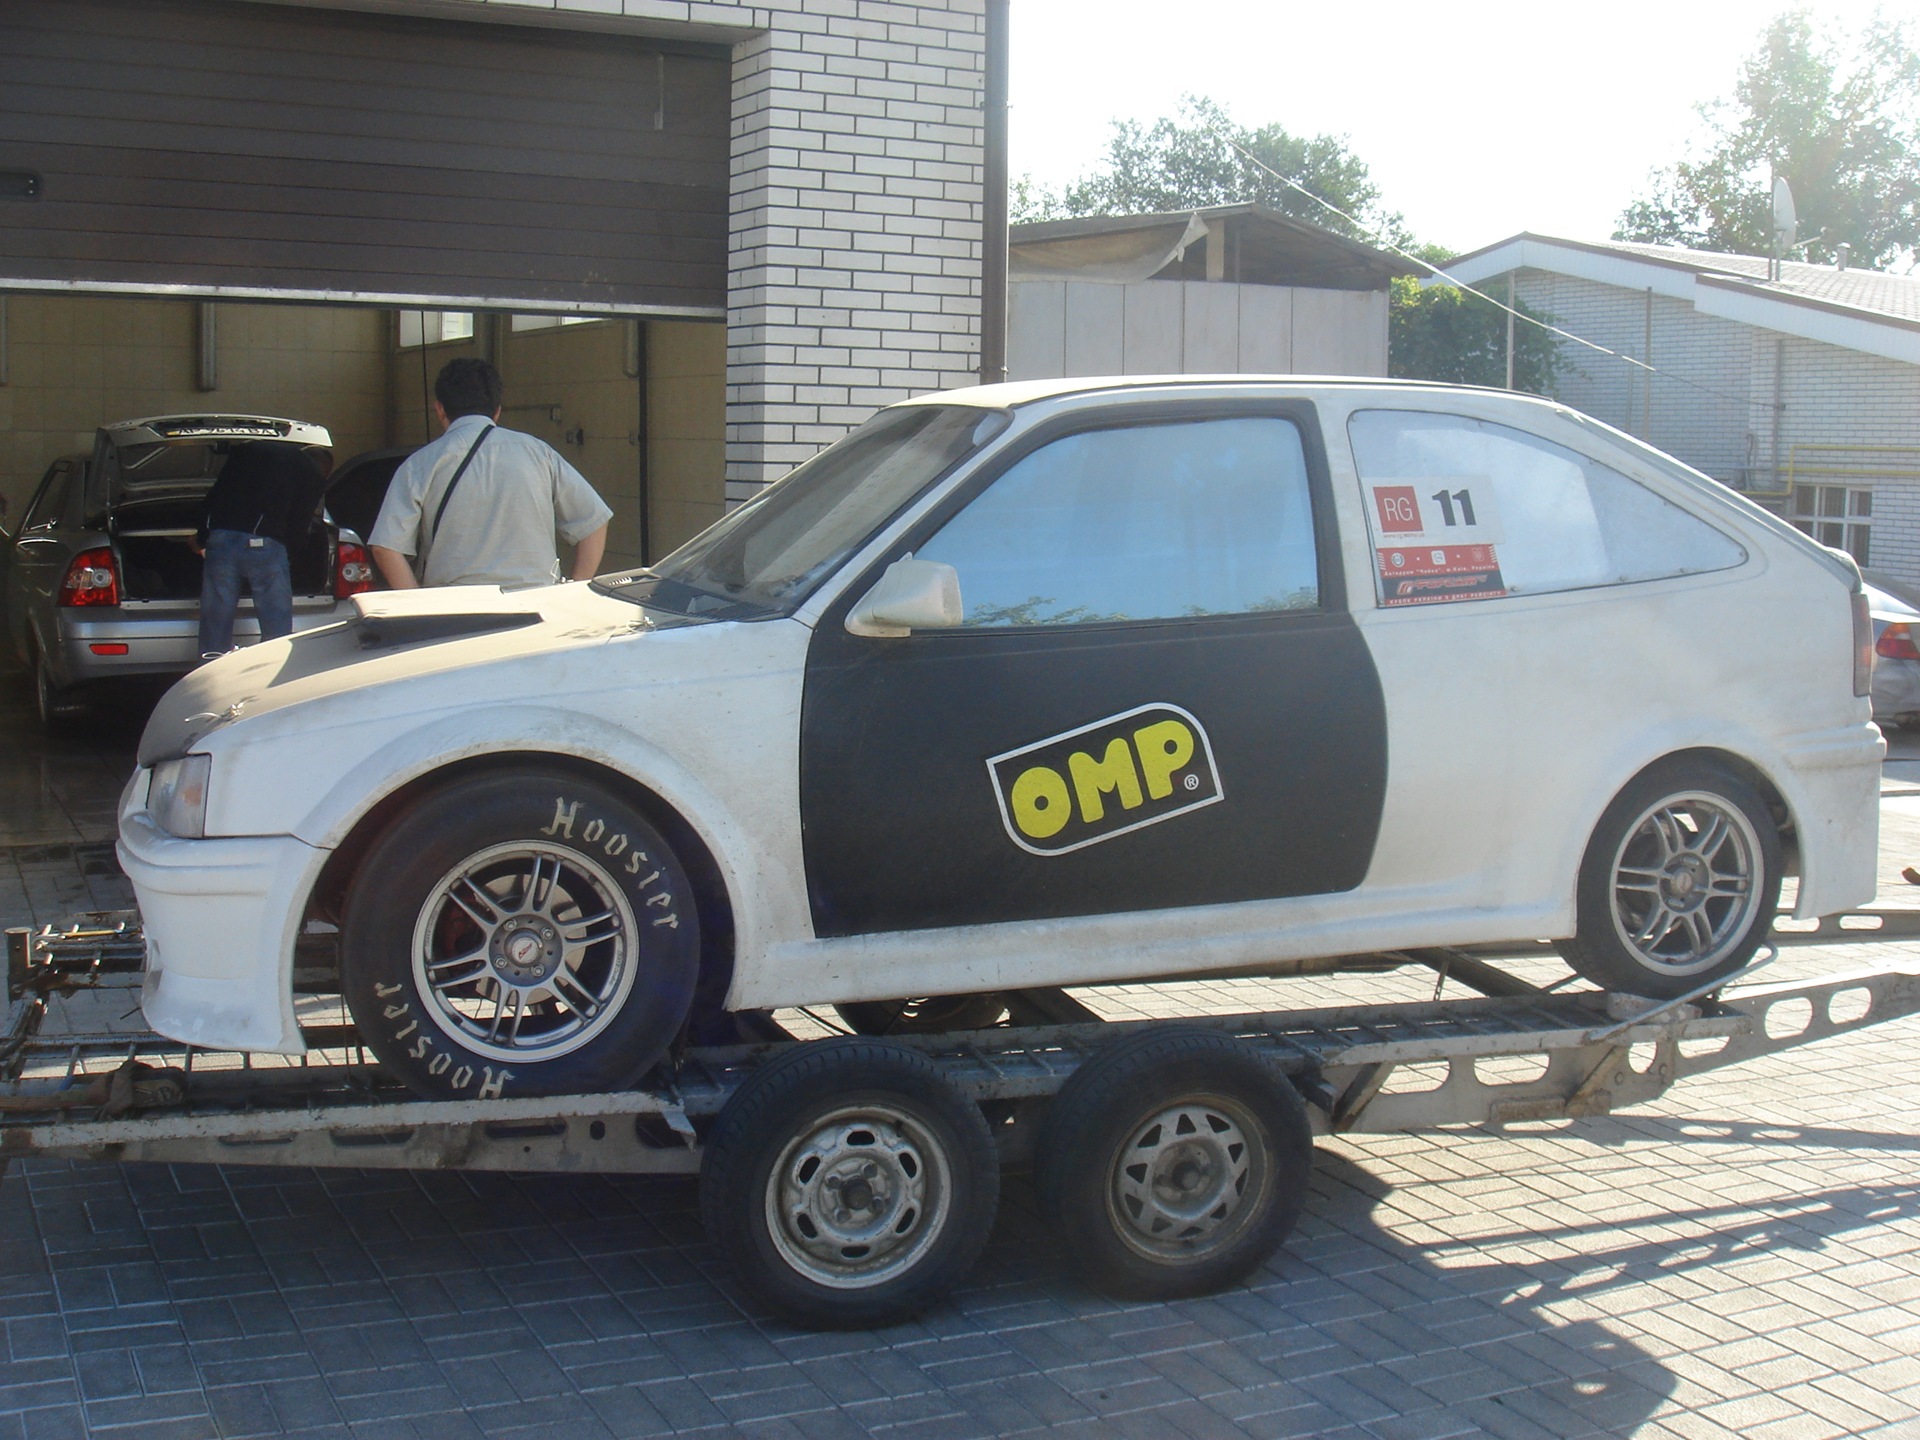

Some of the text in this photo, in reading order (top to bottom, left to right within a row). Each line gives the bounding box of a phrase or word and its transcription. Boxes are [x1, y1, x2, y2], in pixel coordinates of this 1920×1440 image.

[1383, 497, 1414, 521] RG
[1431, 489, 1477, 526] 11
[1011, 720, 1195, 838] OMP
